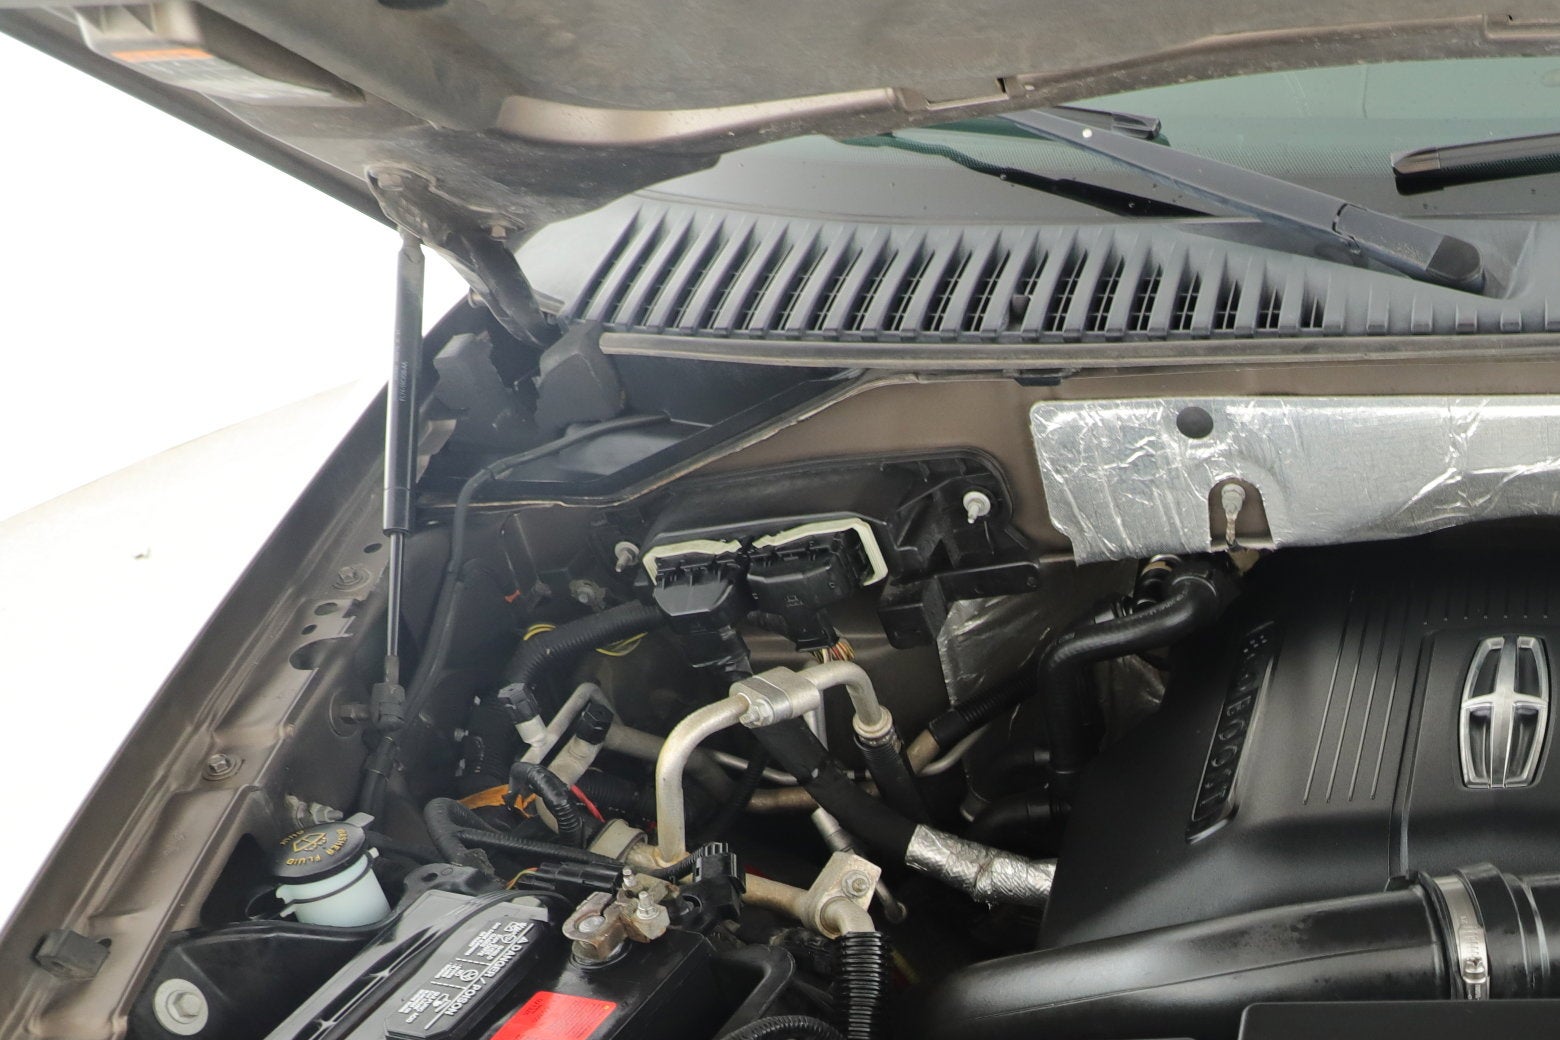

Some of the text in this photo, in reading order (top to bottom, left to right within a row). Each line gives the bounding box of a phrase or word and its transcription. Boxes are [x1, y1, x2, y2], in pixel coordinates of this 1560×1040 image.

[286, 854, 321, 866] FLUID
[484, 944, 523, 978] DANGER
[444, 983, 482, 1016] POISON
